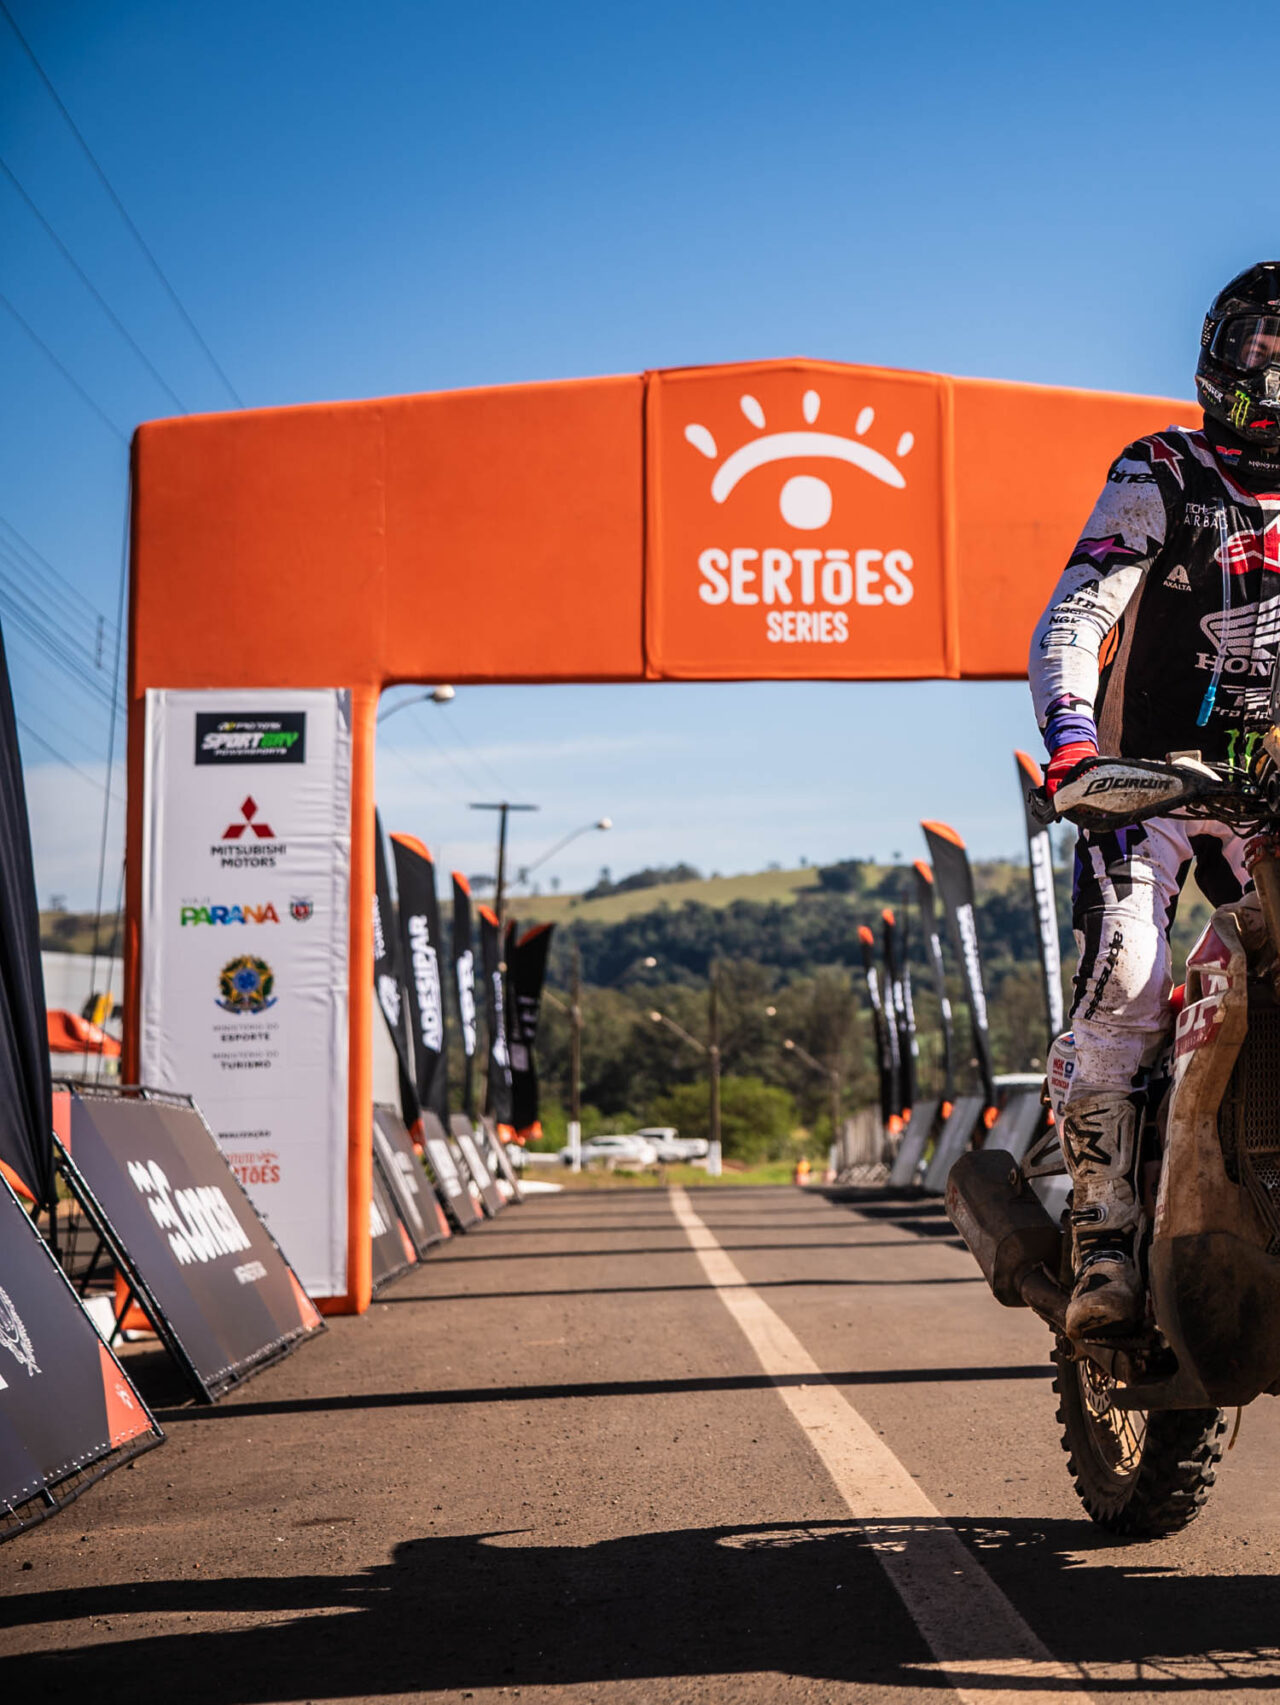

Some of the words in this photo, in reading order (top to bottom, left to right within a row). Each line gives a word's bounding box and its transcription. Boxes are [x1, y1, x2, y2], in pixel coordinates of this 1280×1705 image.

[1162, 579, 1192, 592] AXALTA
[766, 611, 849, 643] SERIES
[1194, 652, 1275, 677] HON
[201, 731, 299, 750] SPORTBAY
[1111, 778, 1171, 790] CIRCUIT
[210, 844, 287, 857] MITSUBISHI
[221, 857, 276, 868] MOTORS
[233, 1164, 281, 1185] TÕES
